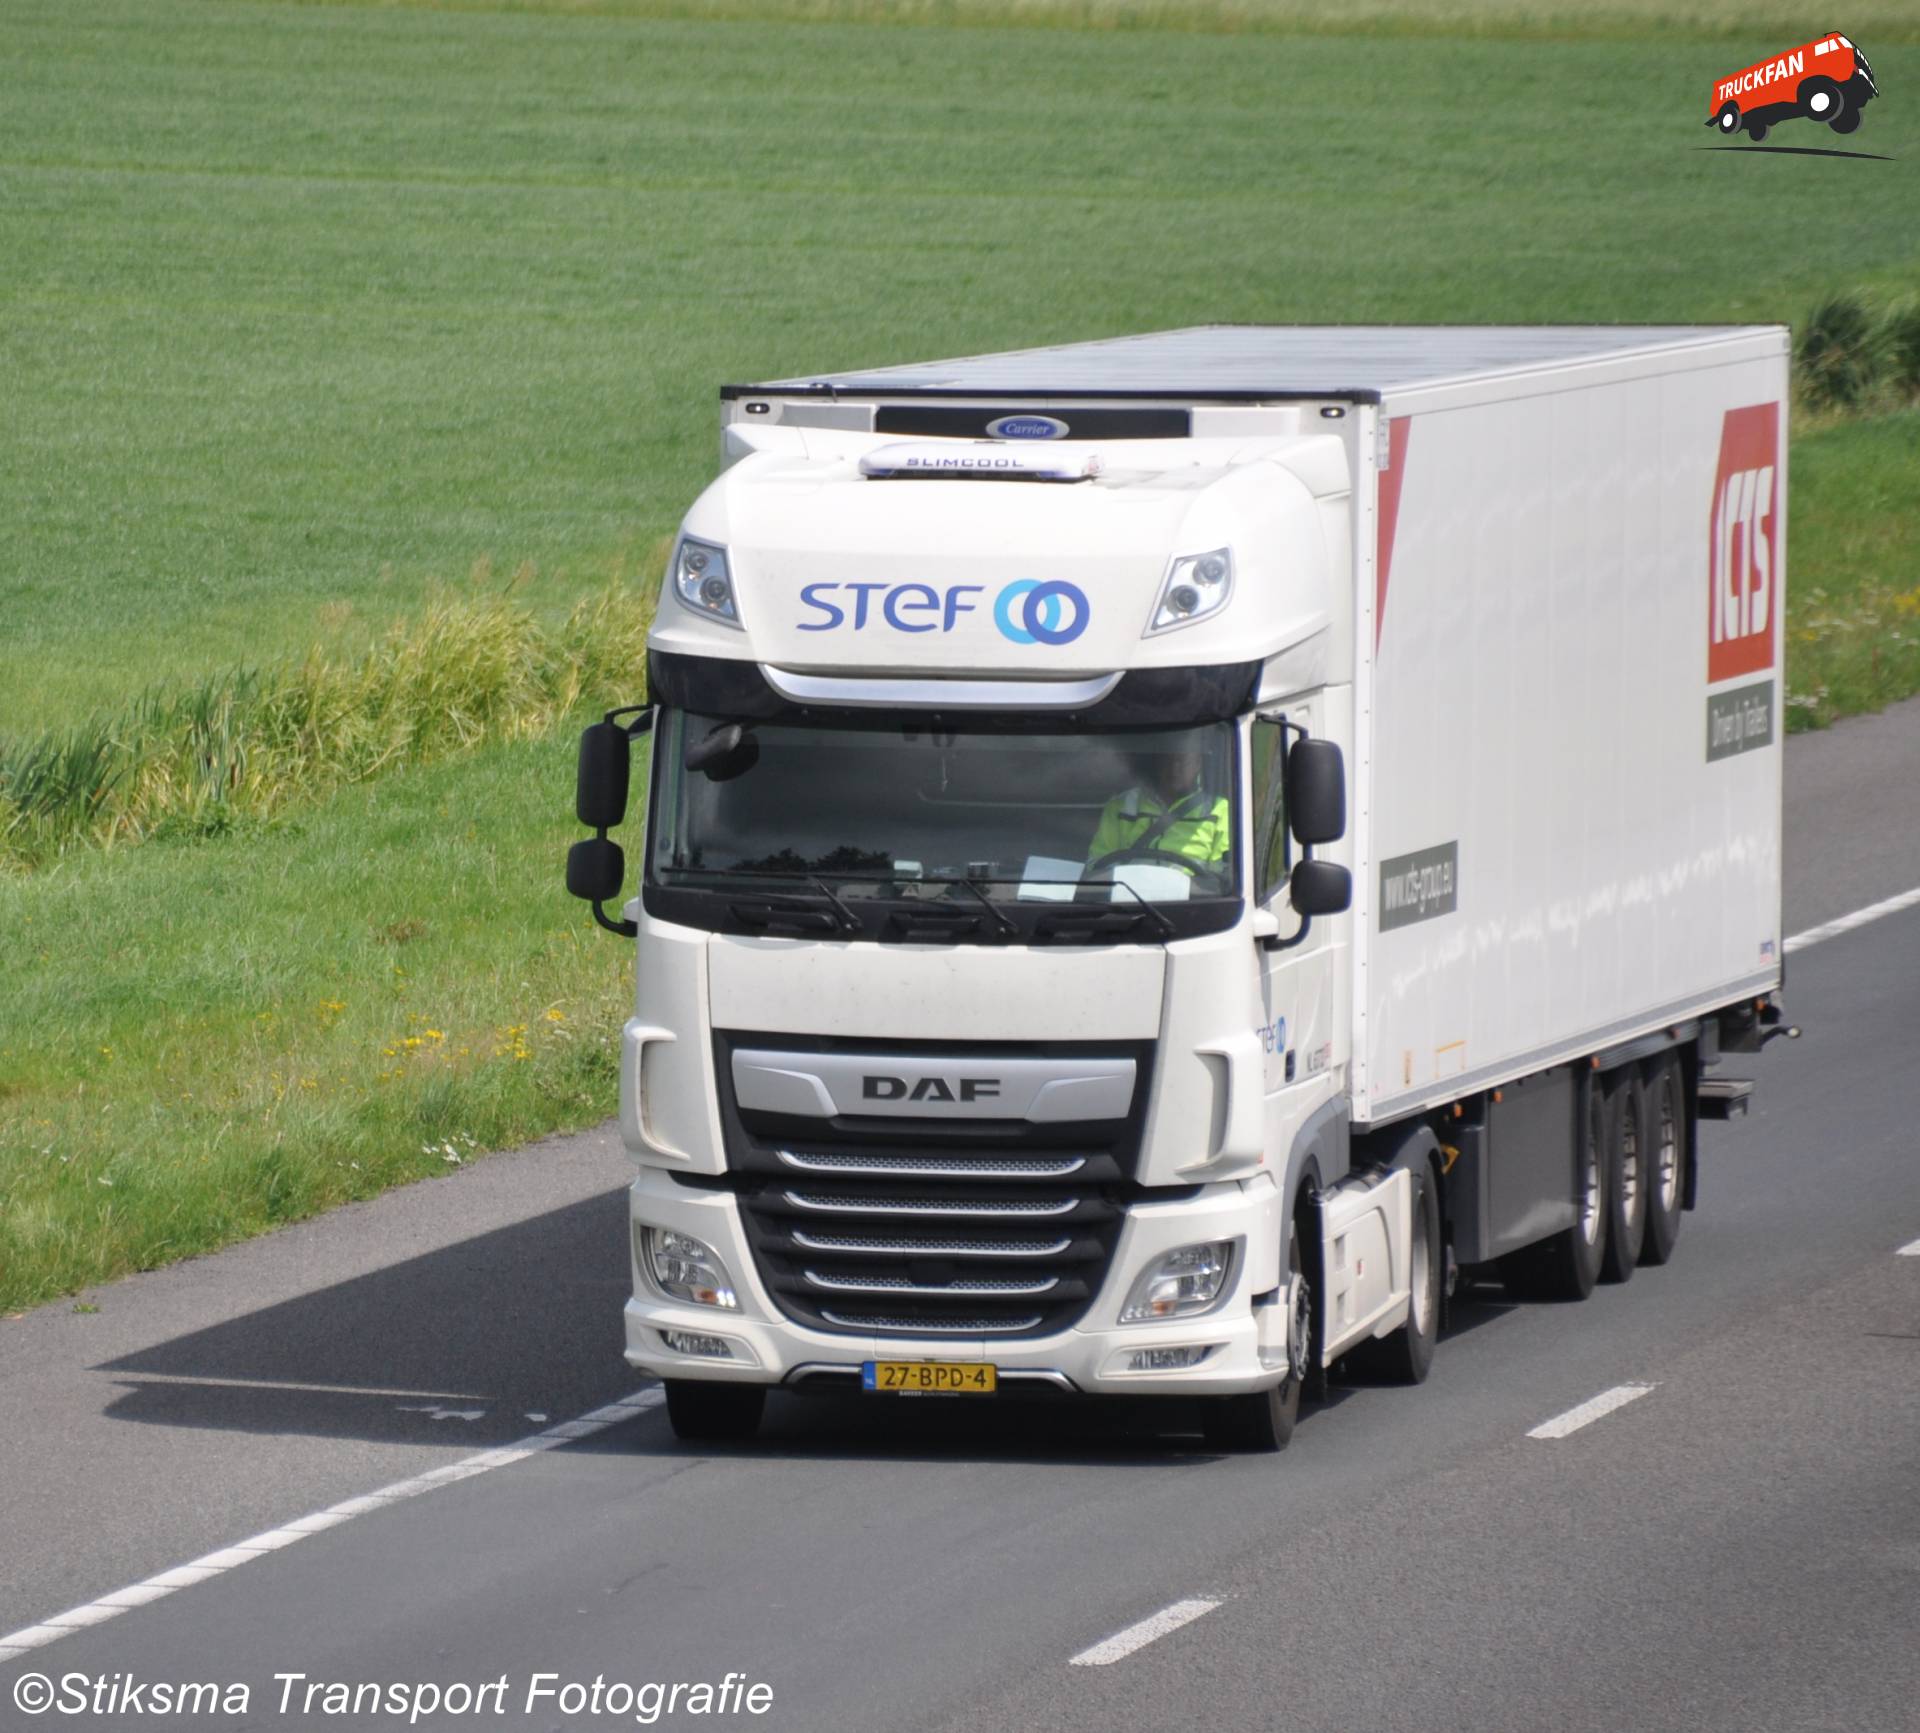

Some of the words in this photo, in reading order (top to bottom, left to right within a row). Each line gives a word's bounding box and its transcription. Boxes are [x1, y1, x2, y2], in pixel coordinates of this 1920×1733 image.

[1004, 422, 1051, 436] Carrier
[906, 457, 1025, 469] SLIMCOOL
[862, 1075, 1001, 1103] DAF
[883, 1366, 987, 1389] 27-BPD-4
